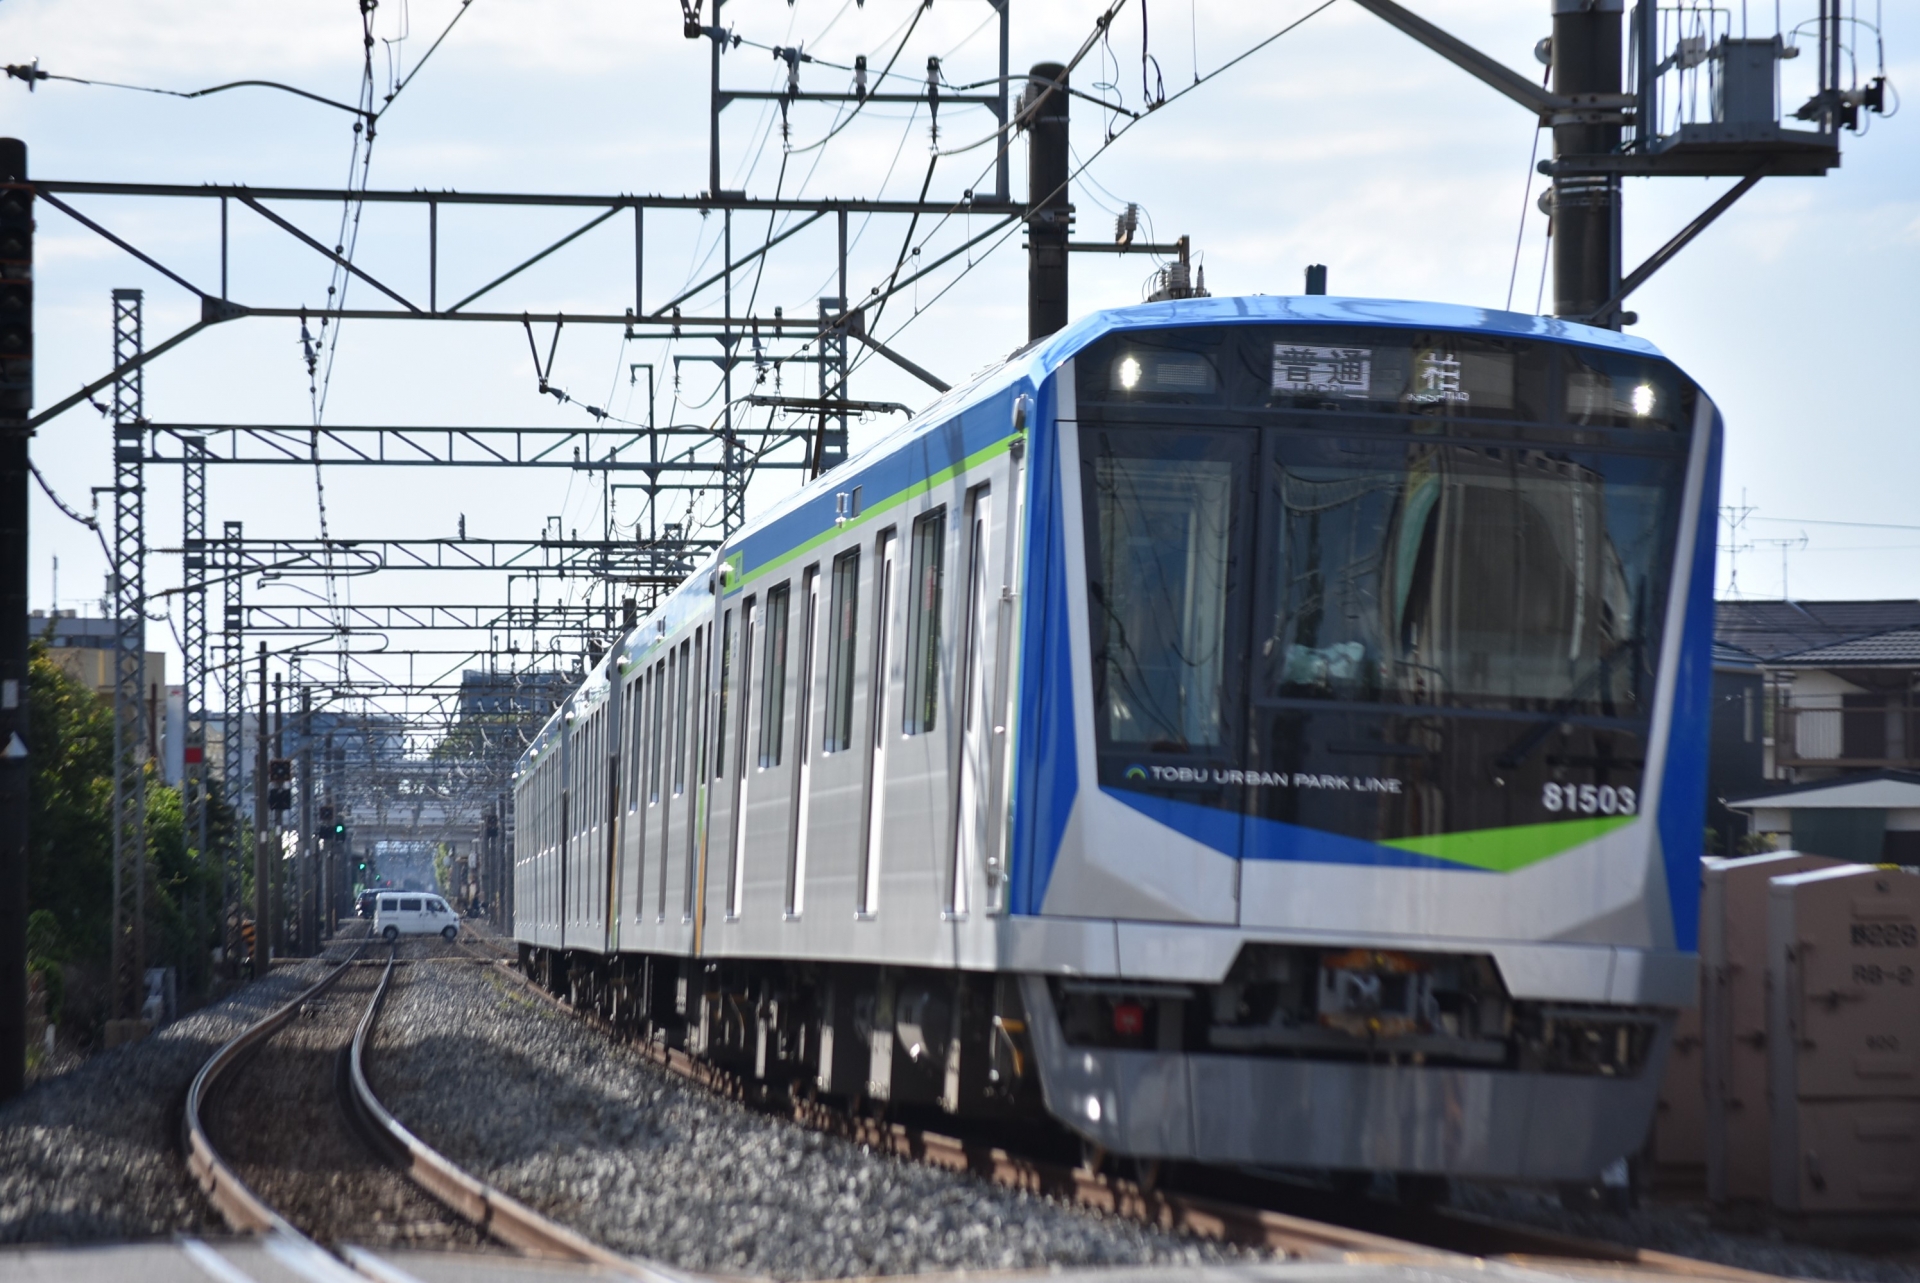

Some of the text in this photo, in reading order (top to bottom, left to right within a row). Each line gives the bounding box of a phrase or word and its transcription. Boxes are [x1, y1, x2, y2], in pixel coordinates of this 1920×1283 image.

[1280, 347, 1364, 385] 普通
[1151, 765, 1403, 794] TOBU URBAN PARK LINE
[1542, 781, 1637, 815] 81503
